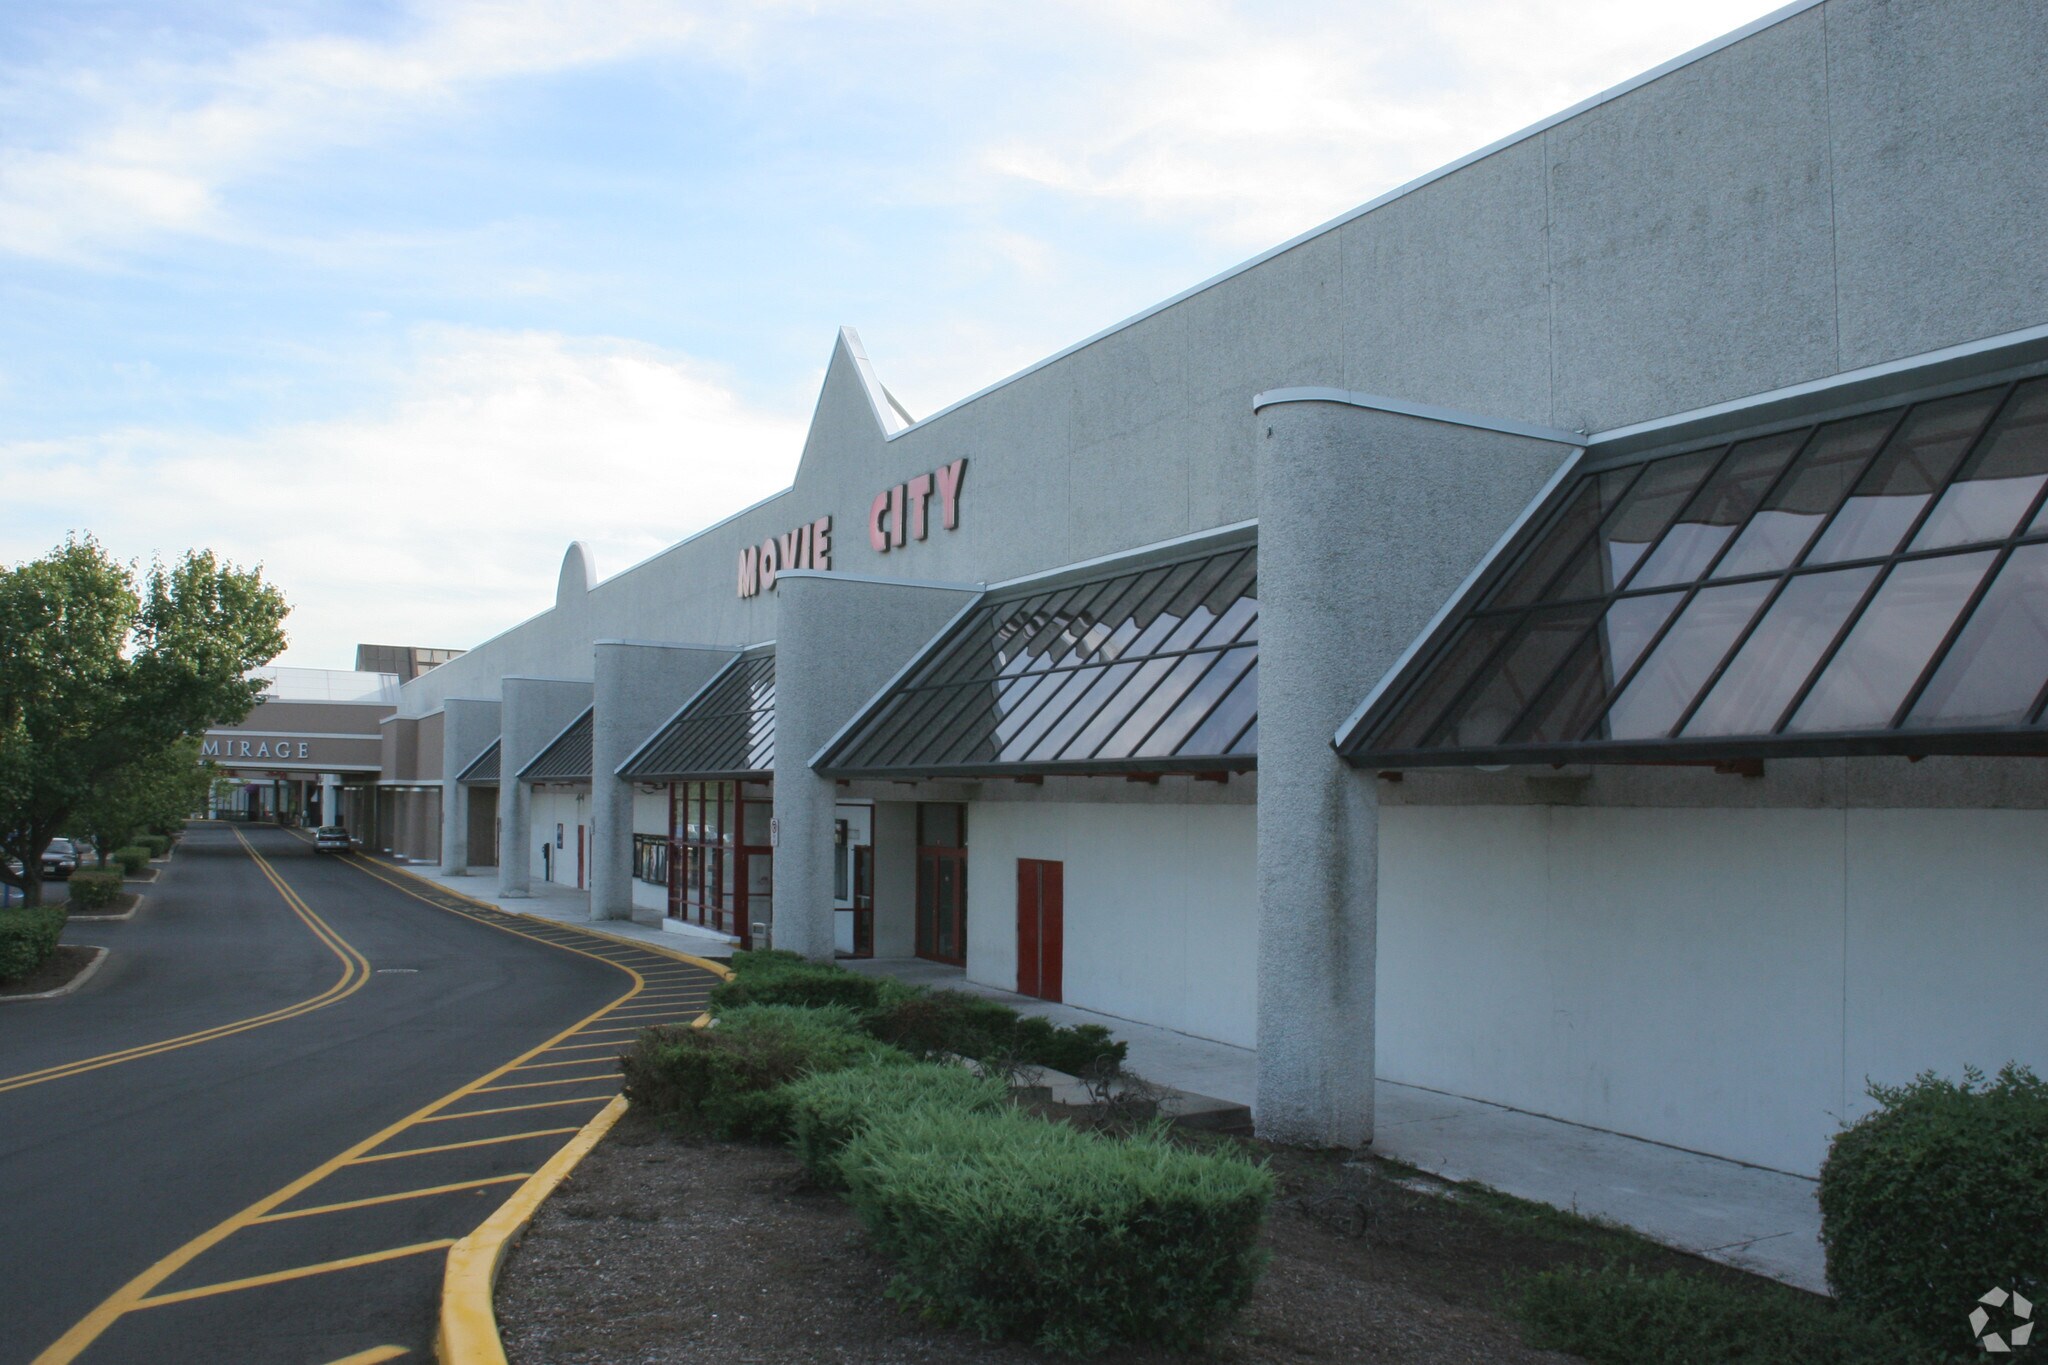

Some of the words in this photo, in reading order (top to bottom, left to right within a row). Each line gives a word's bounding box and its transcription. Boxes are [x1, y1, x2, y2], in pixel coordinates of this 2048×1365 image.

[737, 515, 832, 598] MOVIE
[869, 458, 968, 552] CITY
[201, 740, 309, 759] MIRAGE
